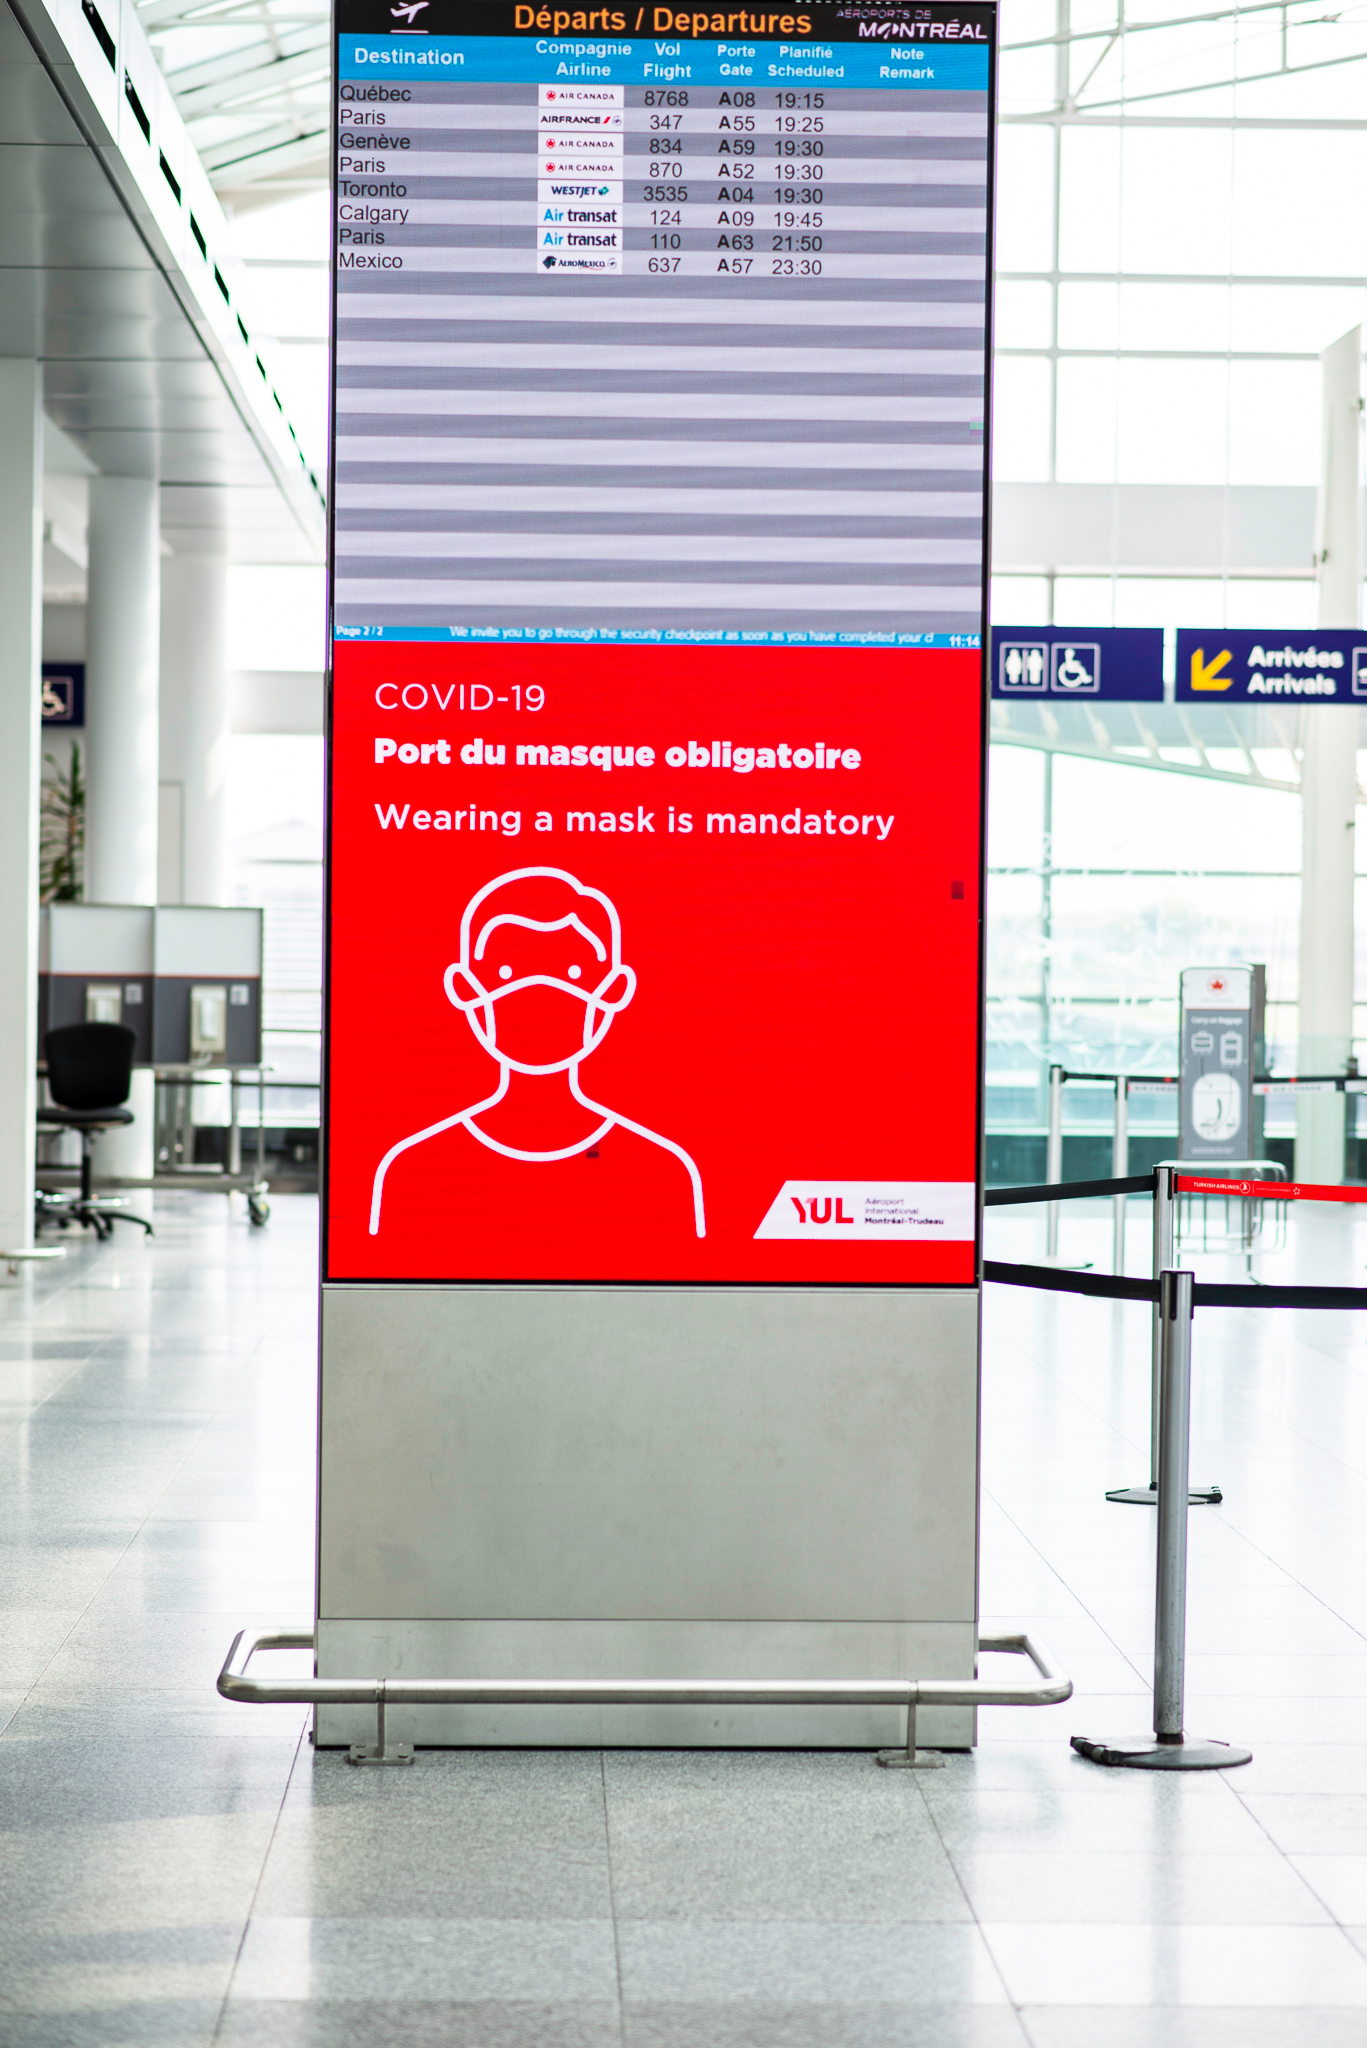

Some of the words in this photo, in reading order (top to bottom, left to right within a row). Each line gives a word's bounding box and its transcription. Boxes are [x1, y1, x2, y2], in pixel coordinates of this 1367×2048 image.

[515, 5, 626, 35] Départs
[635, 8, 644, 30] /
[653, 7, 812, 37] Departures
[836, 8, 910, 19] AÉROPORTS
[915, 10, 931, 19] DE
[859, 19, 988, 40] MONTRÉAL
[354, 47, 464, 65] Destination
[536, 40, 632, 57] Compagnie
[654, 42, 681, 56] Vol
[717, 45, 756, 57] Porte
[780, 46, 833, 58] Planifié
[891, 48, 924, 60] Note
[556, 62, 611, 77] Airline
[643, 63, 692, 78] Flight
[720, 65, 753, 76] Gate
[768, 65, 844, 78] Scheduled
[880, 66, 935, 79] Remark
[340, 86, 411, 103] Québec
[644, 90, 689, 107] 8768
[719, 92, 755, 106] A08
[775, 94, 824, 108] 19:15
[340, 109, 386, 125] Paris
[650, 115, 683, 131] 347
[719, 116, 755, 131] A55
[775, 118, 824, 132] 19:25
[340, 132, 411, 149] Genève
[649, 139, 683, 154] 834
[718, 140, 755, 155] A59
[775, 141, 823, 156] 19:30
[340, 158, 385, 173] Paris
[649, 163, 683, 178] 870
[718, 163, 754, 179] A52
[775, 165, 823, 180] 19:30
[340, 181, 407, 197] Toronto
[551, 186, 597, 198] WESTJET
[643, 186, 688, 202] 3535
[718, 188, 754, 202] A04
[774, 189, 823, 204] 19:30
[340, 205, 409, 225] Calgary
[544, 209, 564, 221] Air
[567, 209, 617, 222] transat
[651, 210, 681, 225] 124
[718, 212, 754, 226] A09
[774, 213, 823, 227] 19:45
[340, 229, 385, 244] Paris
[544, 232, 563, 245] Air
[567, 233, 617, 246] transat
[651, 234, 681, 249] 110
[717, 235, 754, 250] A63
[772, 236, 822, 251] 21:50
[340, 253, 403, 269] Mexico
[648, 257, 681, 273] 637
[717, 259, 753, 274] A57
[772, 260, 822, 275] 23:30
[336, 626, 361, 637] Page
[450, 626, 468, 637] We
[503, 629, 522, 639] you
[525, 628, 536, 637] to
[538, 630, 553, 640] go
[555, 628, 597, 641] through
[600, 629, 617, 638] the
[725, 632, 739, 640] as
[742, 632, 768, 640] soon
[771, 632, 784, 641] as
[786, 632, 807, 643] you
[809, 630, 836, 642] have
[898, 633, 923, 644] your
[949, 635, 980, 647] 11:14
[1247, 645, 1344, 668] Arrivées
[1247, 672, 1336, 695] Arrivals
[374, 683, 545, 712] COVID-19
[374, 738, 451, 764] Port
[461, 739, 505, 765] du
[516, 743, 655, 772] masque
[665, 741, 861, 773] obligatoire
[374, 804, 522, 836] Wearing
[534, 812, 553, 831] a
[566, 806, 656, 833] mask
[668, 807, 693, 833] is
[706, 809, 895, 841] mandatory
[791, 1197, 854, 1224] YUL
[865, 1217, 944, 1225] Montréal-Trudeau
